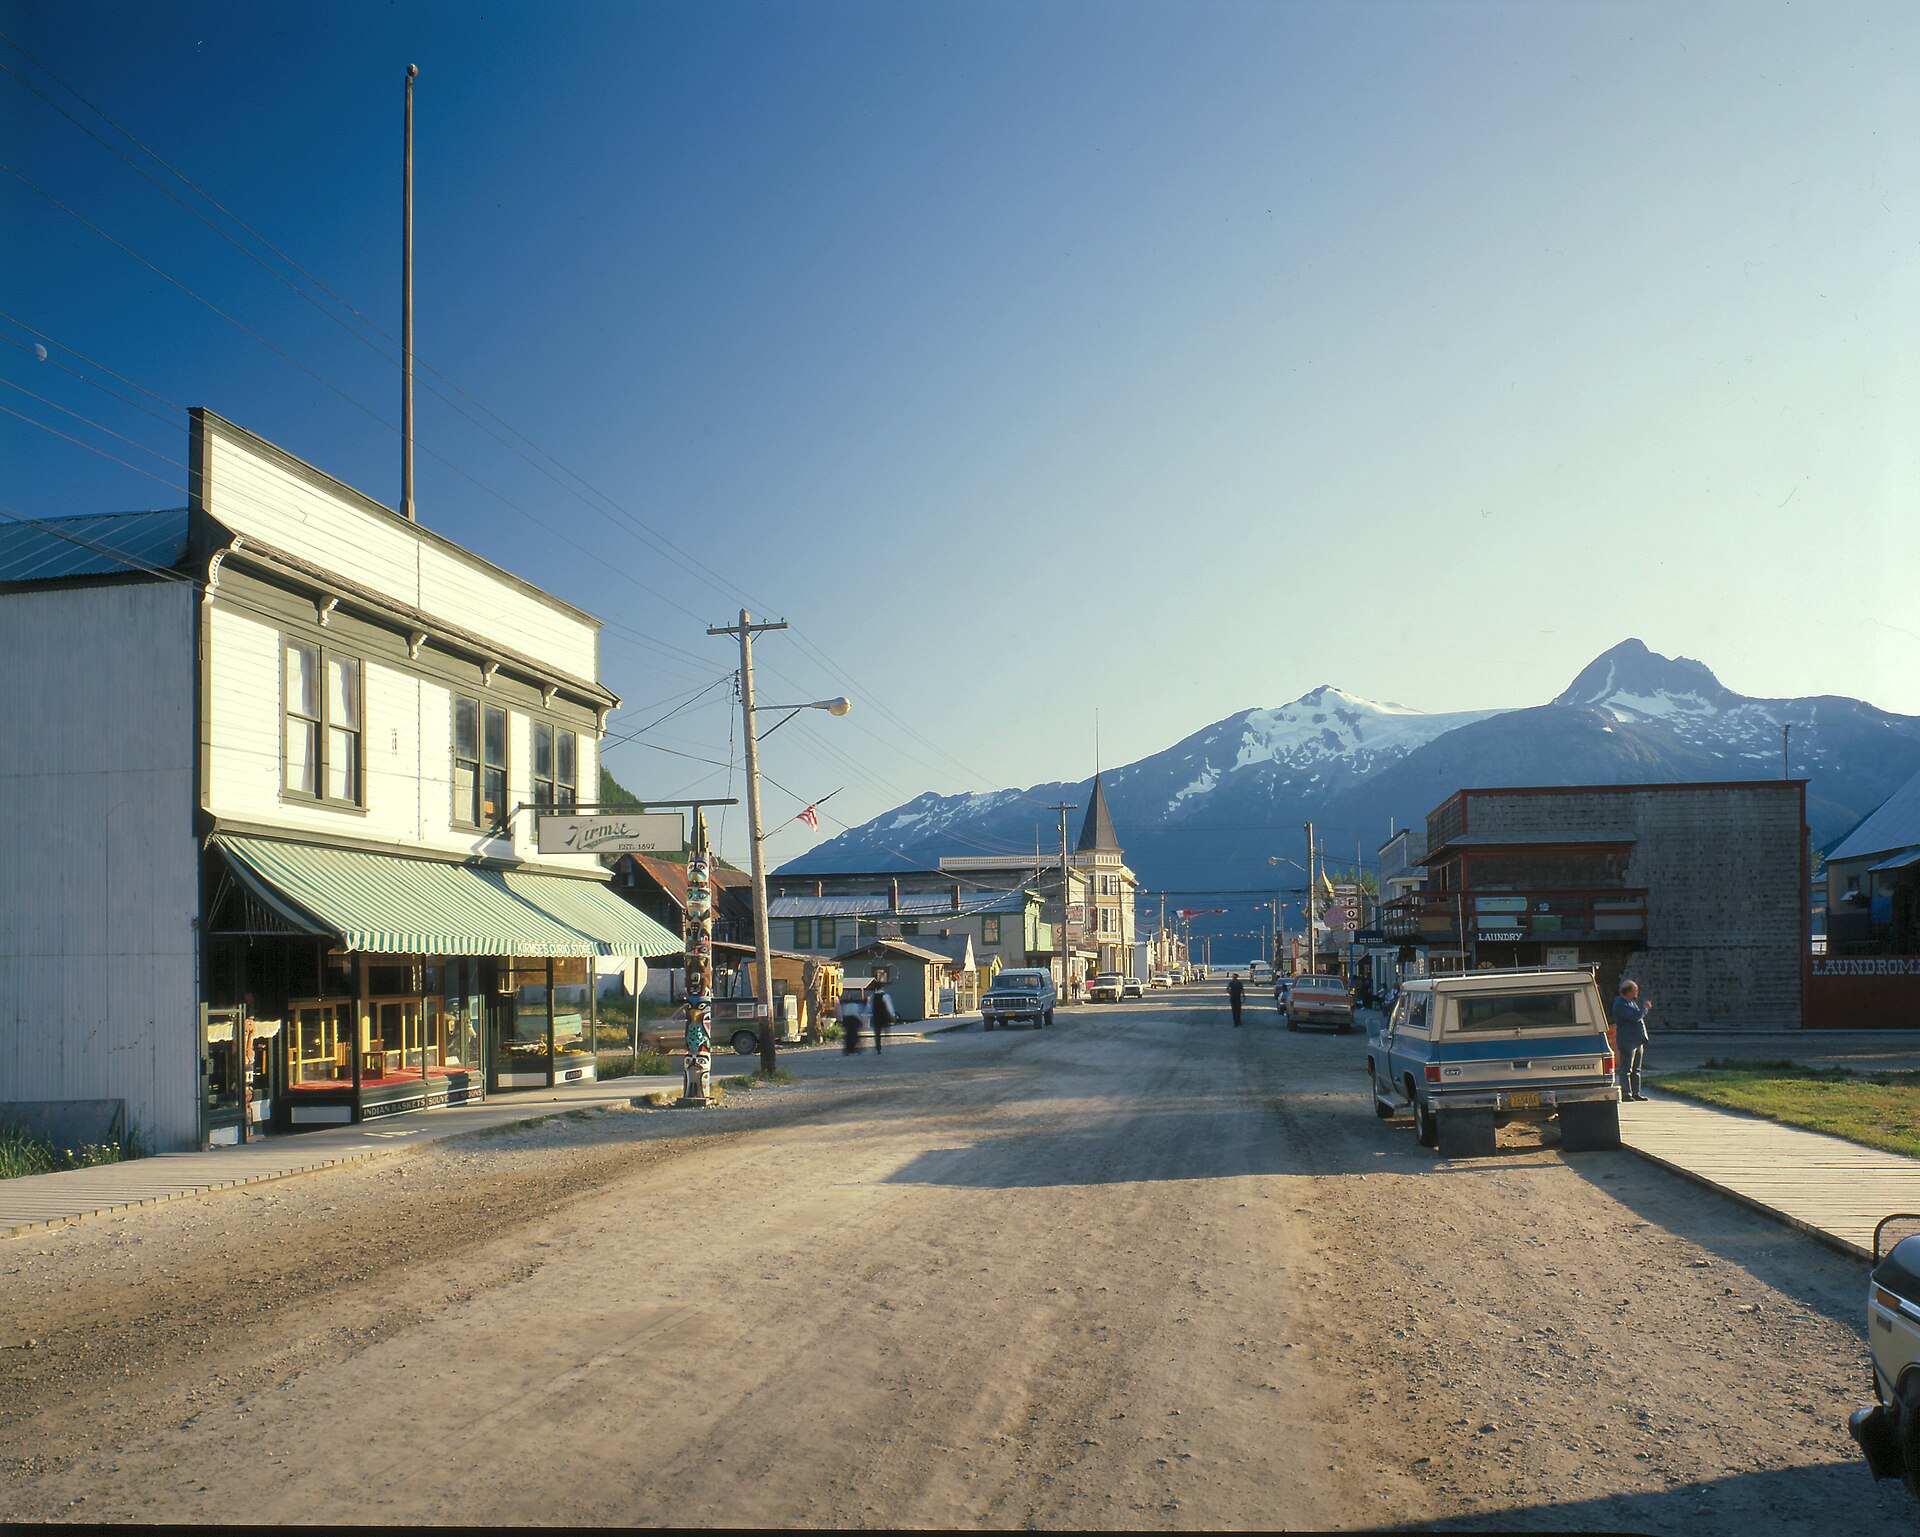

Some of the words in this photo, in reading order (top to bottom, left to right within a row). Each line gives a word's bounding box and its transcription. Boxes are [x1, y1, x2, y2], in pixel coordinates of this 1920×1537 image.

[1478, 933, 1523, 941] LAUNDRY
[571, 943, 592, 955] STORE
[1552, 1063, 1596, 1071] CHEVROLET
[363, 1104, 390, 1116] INDIAN
[391, 1098, 425, 1113] BASKETS
